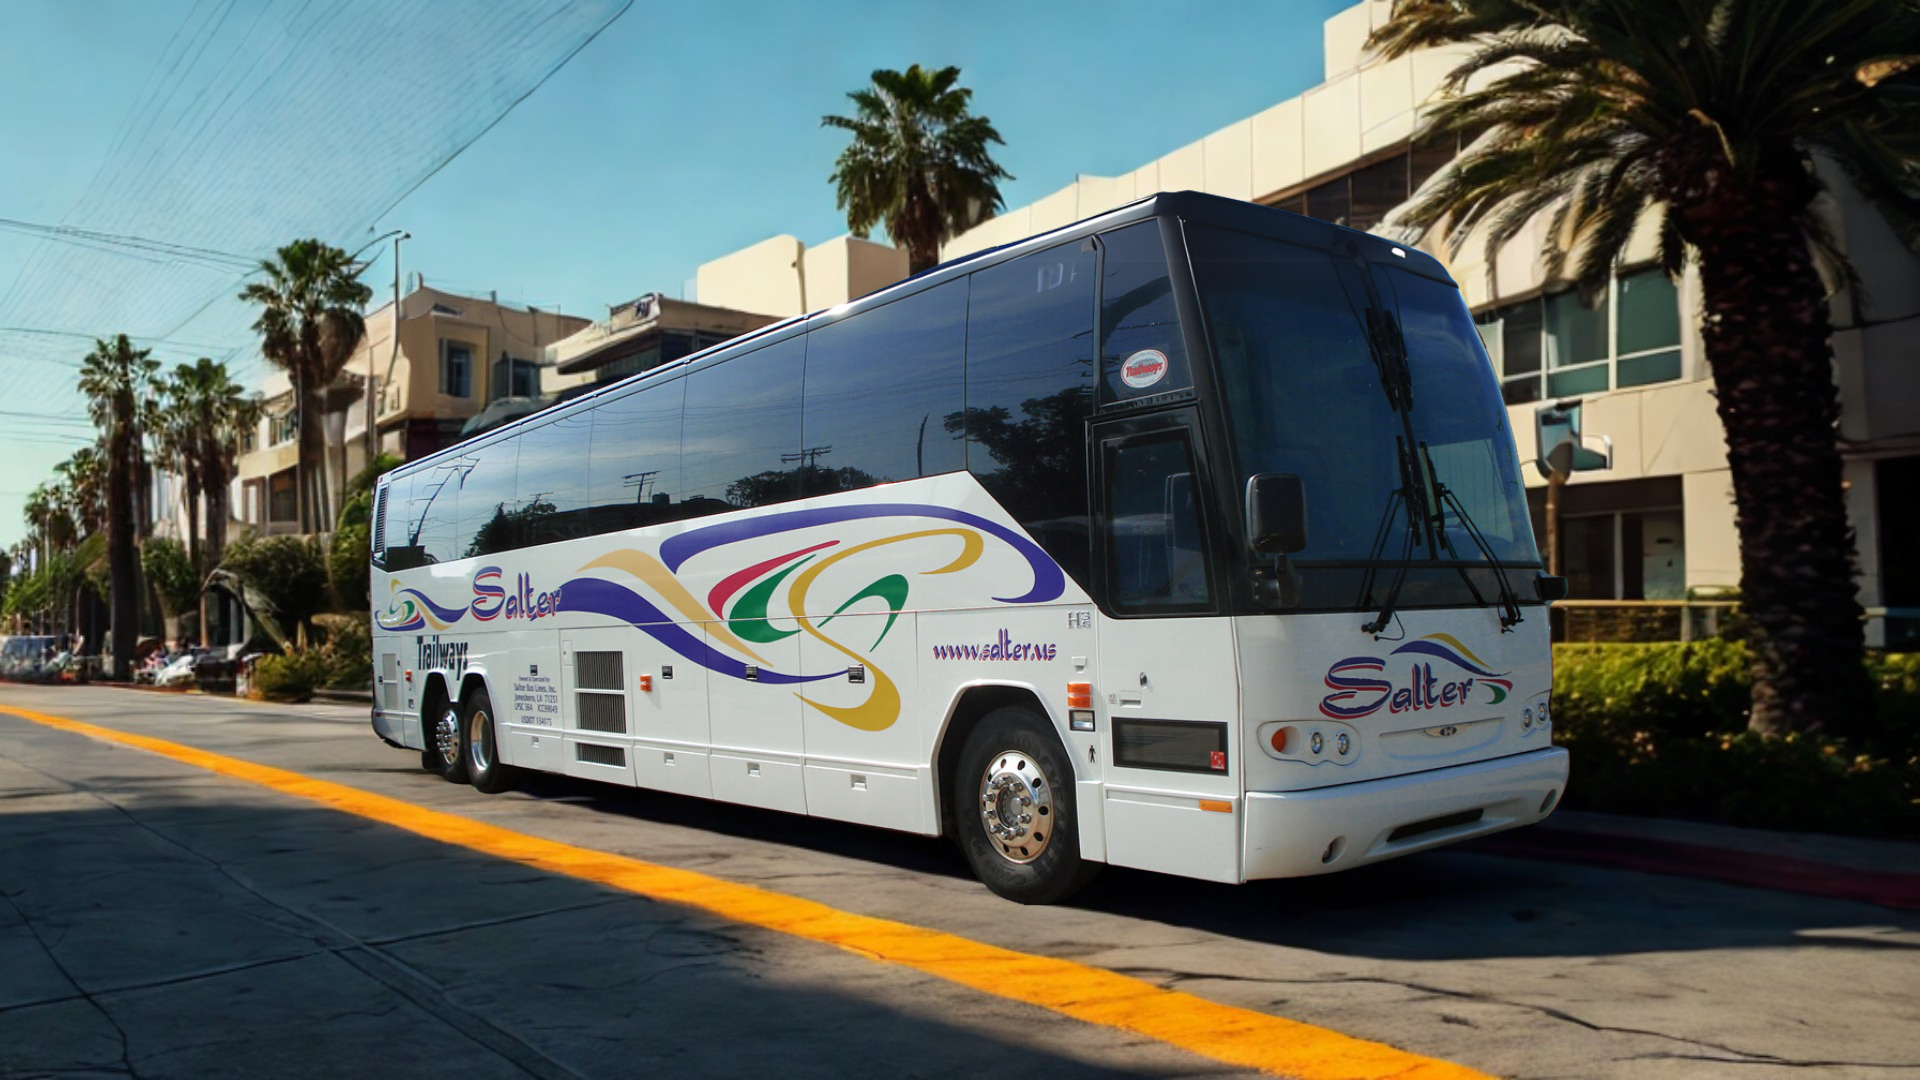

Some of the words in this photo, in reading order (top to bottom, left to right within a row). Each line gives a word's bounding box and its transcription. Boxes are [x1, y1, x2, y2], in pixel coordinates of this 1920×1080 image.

[471, 566, 561, 621] Salter
[417, 635, 468, 680] Trailways
[933, 628, 1057, 661] www.salter.us
[514, 683, 526, 692] Salter
[1319, 657, 1473, 719] Salter
